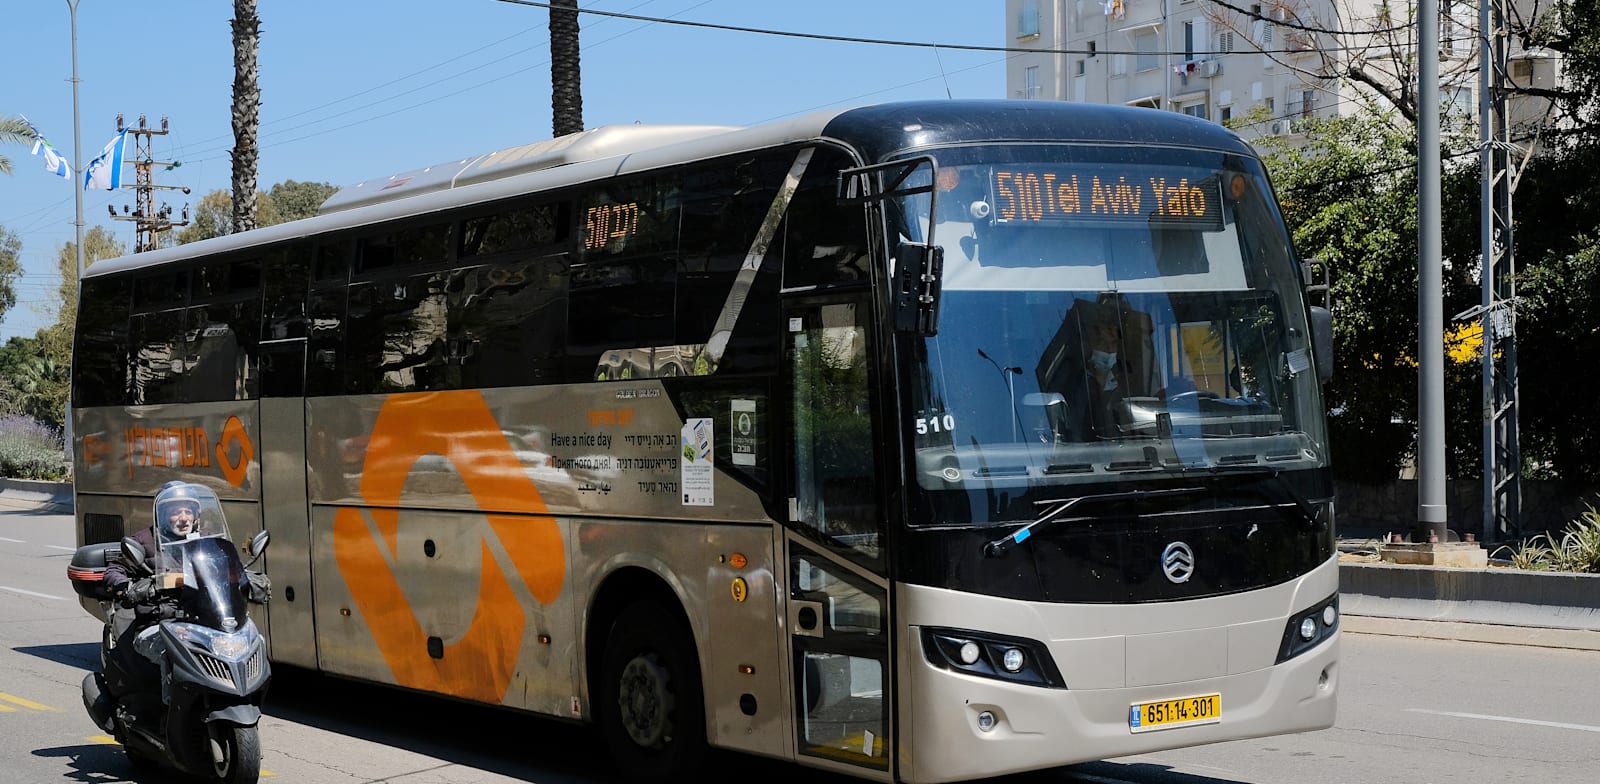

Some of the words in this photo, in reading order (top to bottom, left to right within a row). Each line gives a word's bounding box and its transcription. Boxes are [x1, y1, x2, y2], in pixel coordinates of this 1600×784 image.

[997, 171, 1042, 222] 510
[1043, 173, 1081, 214] Tel
[1091, 175, 1141, 215] Aviv
[1150, 177, 1206, 217] Yafo
[585, 205, 610, 250] 510
[916, 414, 955, 435] 510
[551, 432, 570, 447] Have
[571, 435, 577, 447] a
[578, 432, 595, 447] nice
[597, 432, 612, 450] day
[551, 455, 592, 472] Приятного
